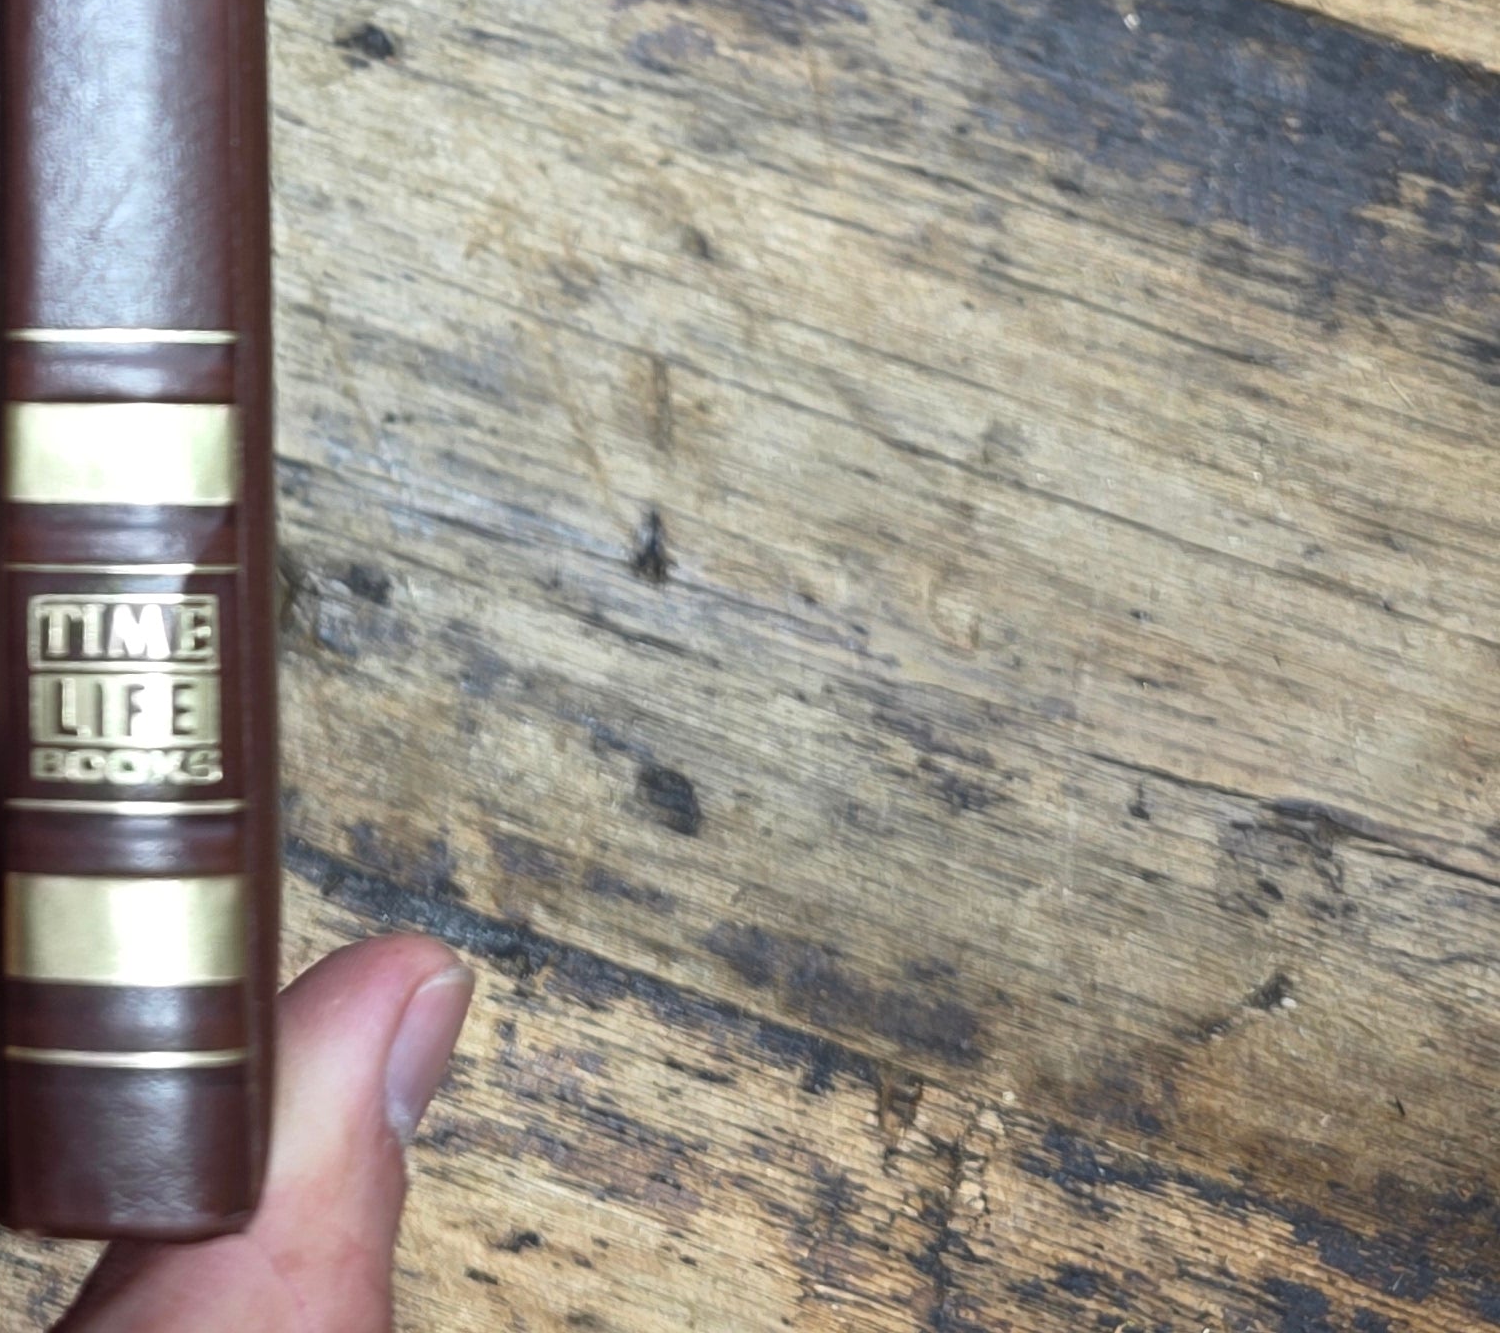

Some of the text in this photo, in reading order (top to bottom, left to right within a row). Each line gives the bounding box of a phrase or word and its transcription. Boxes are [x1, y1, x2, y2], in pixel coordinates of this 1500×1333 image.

[34, 602, 215, 660] TIME
[46, 677, 196, 737] LIFE
[29, 747, 223, 786] BOOKS
